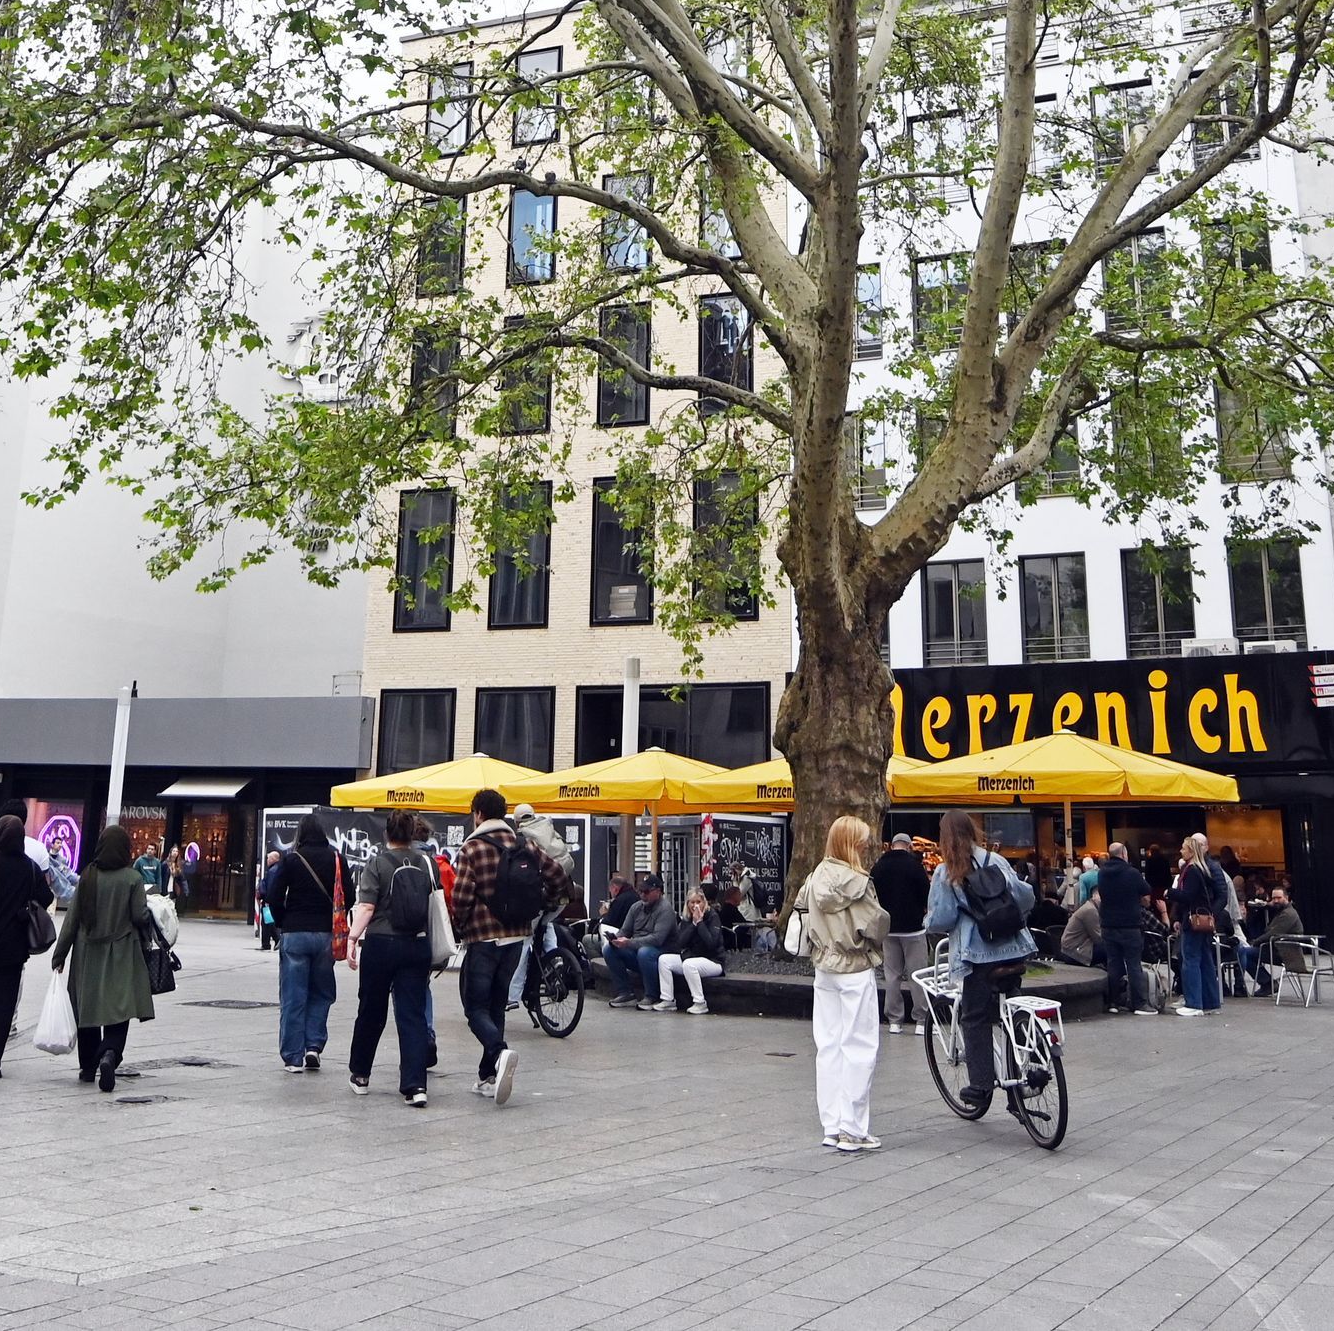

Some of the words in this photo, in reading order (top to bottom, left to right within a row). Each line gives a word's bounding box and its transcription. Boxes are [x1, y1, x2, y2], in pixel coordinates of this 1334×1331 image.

[977, 776, 1035, 792] Merzenich
[386, 790, 425, 803] Merzenich
[558, 785, 600, 799] Merzenich
[120, 806, 167, 820] AROVSK
